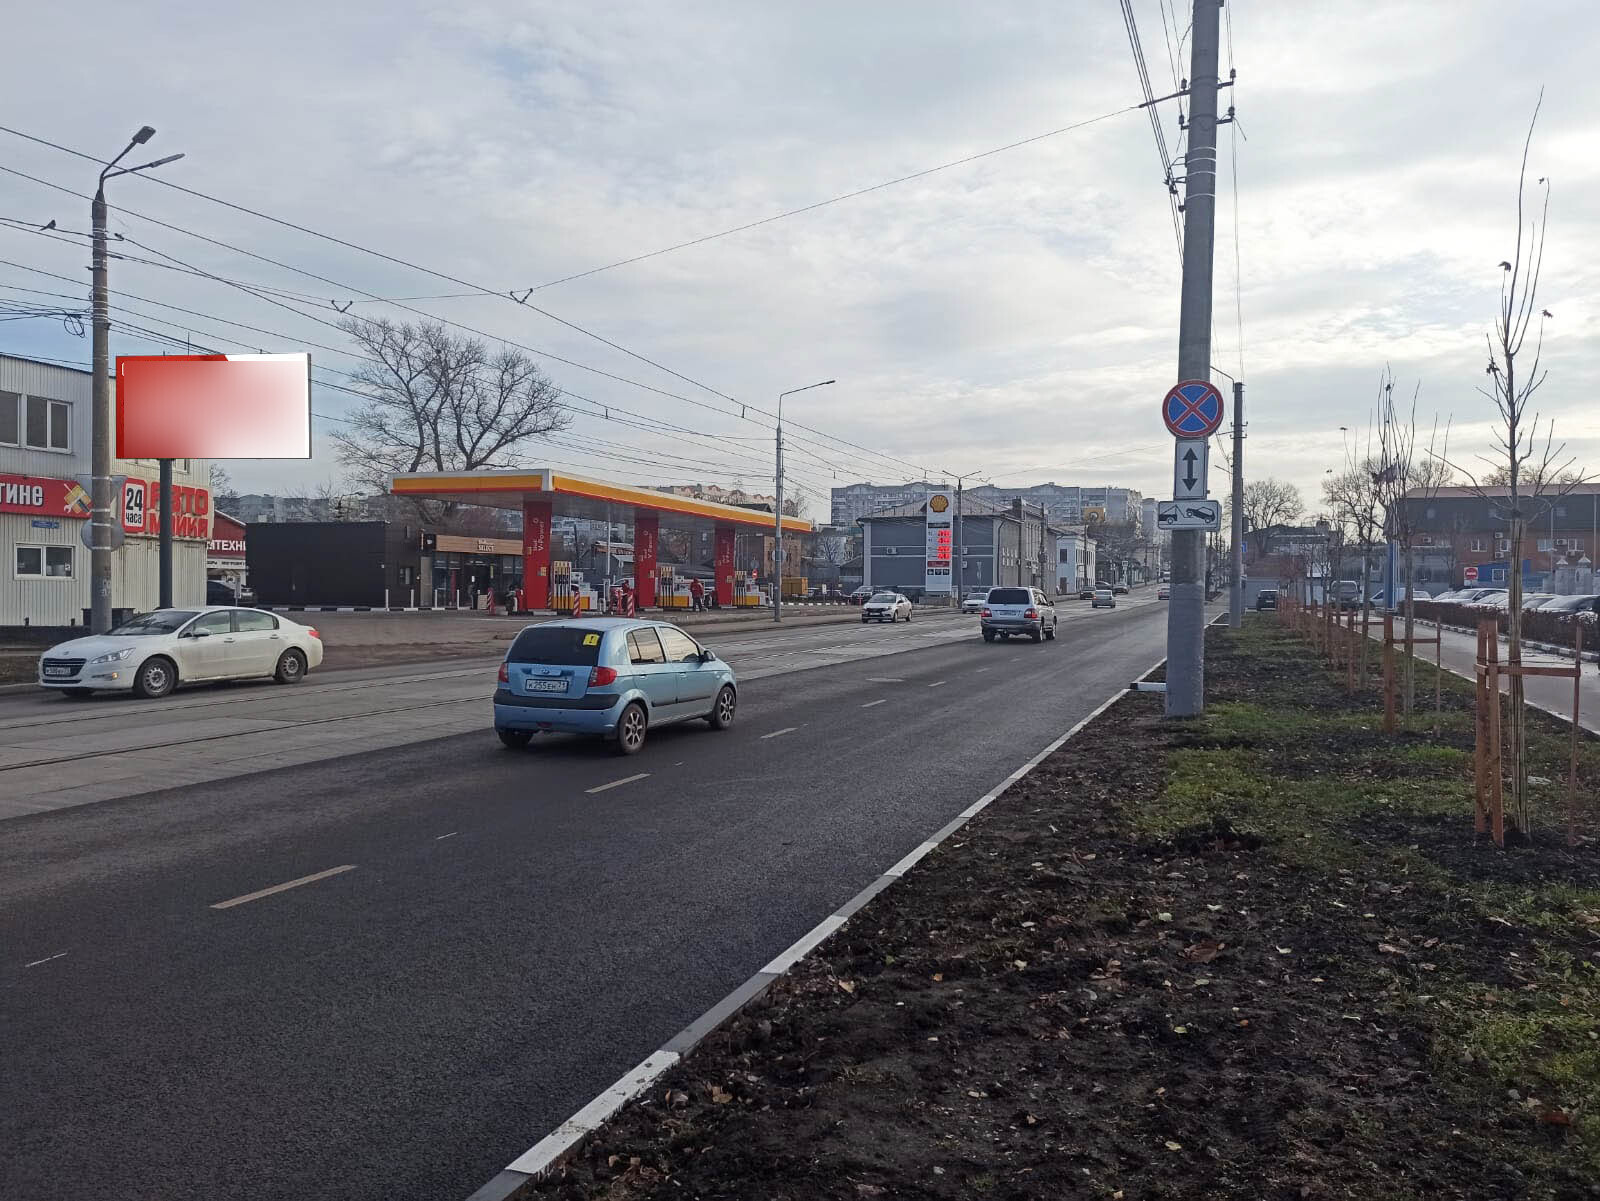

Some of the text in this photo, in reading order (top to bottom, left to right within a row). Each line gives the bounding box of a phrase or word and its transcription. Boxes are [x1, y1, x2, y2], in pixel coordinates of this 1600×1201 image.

[126, 488, 142, 512] 24
[151, 482, 208, 515] АВТО
[126, 513, 142, 524] часа
[150, 513, 208, 538] МЙКА
